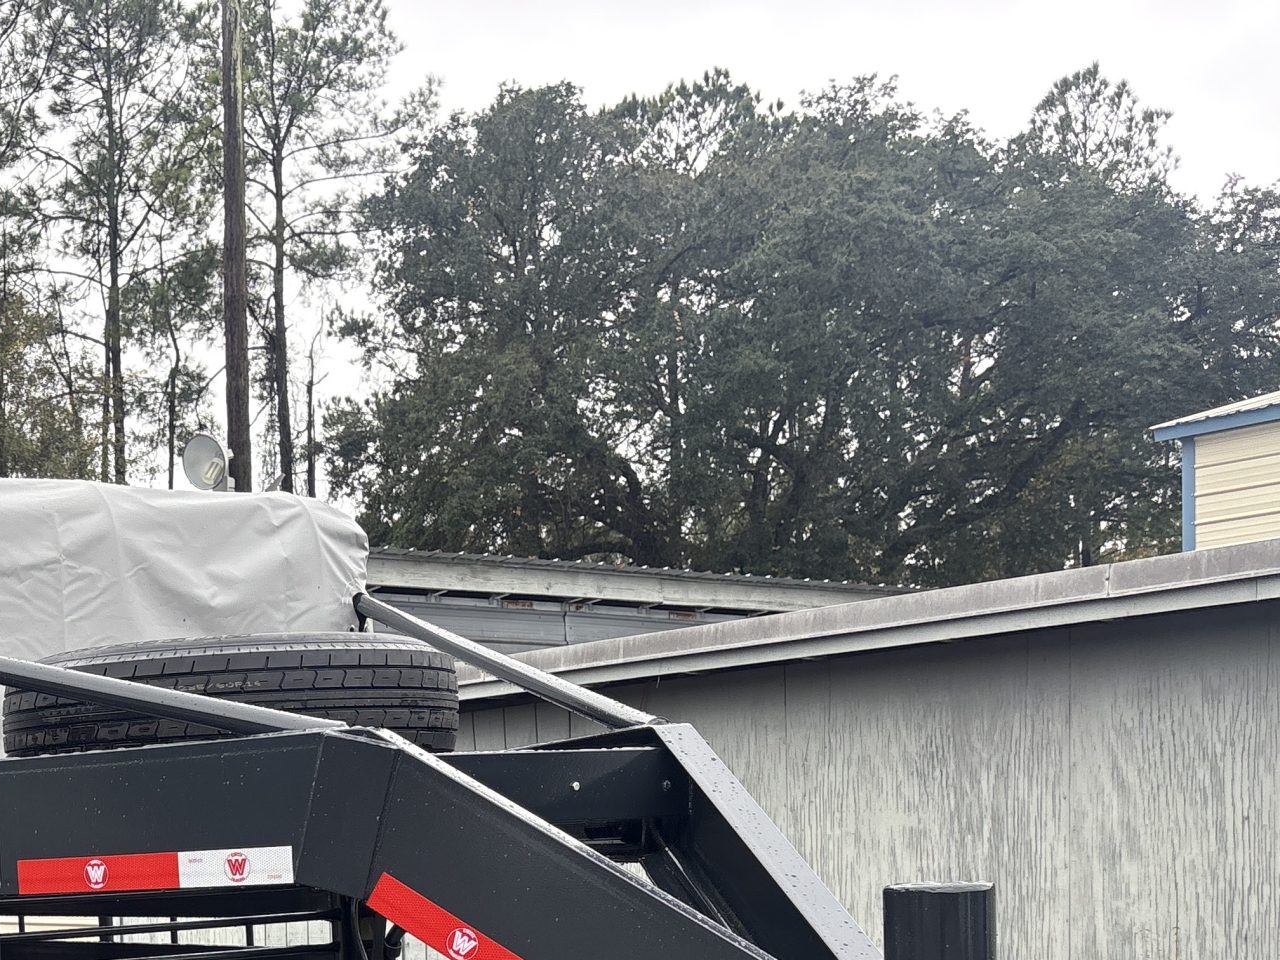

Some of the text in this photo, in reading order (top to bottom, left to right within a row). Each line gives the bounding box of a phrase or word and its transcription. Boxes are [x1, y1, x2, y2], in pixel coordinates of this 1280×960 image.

[86, 865, 105, 882] W
[227, 858, 247, 876] W
[452, 930, 478, 955] W
